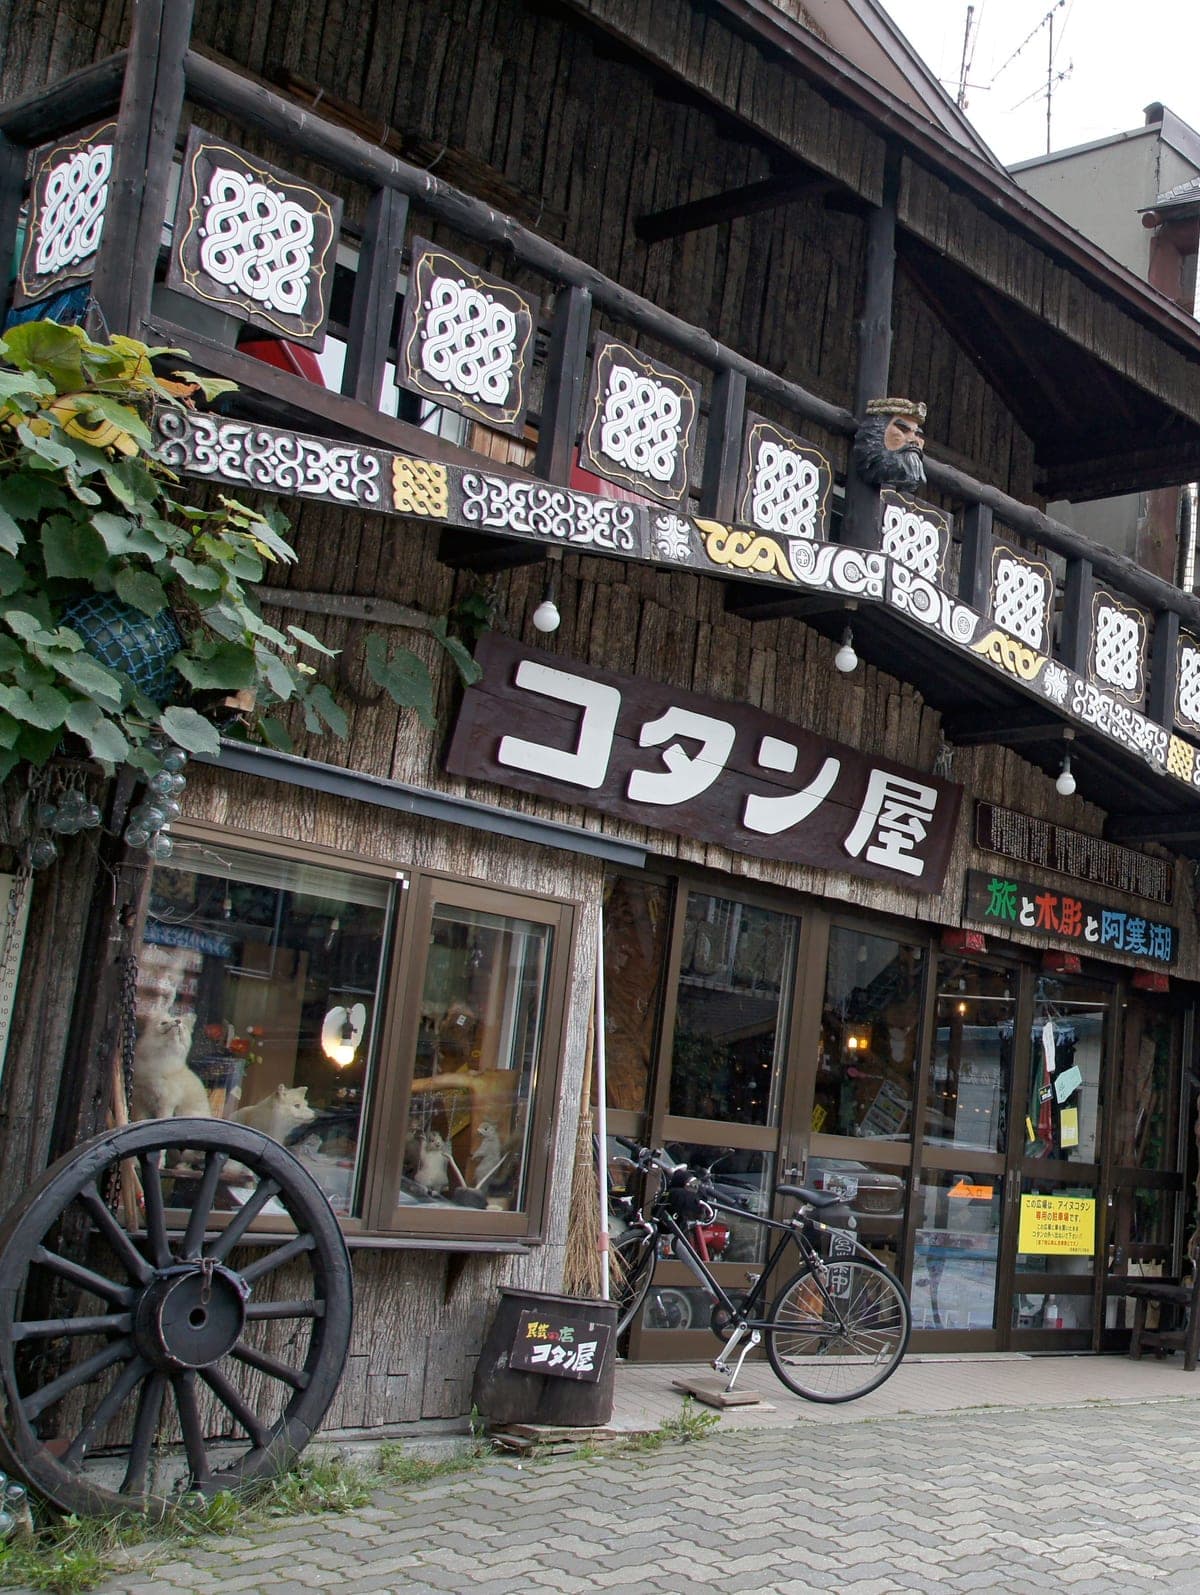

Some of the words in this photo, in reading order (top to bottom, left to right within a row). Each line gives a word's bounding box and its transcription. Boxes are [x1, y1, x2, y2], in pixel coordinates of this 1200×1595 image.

[498, 660, 938, 877] コタン屋
[985, 877, 1172, 962] 旅と木彫と阿寒湖
[525, 1321, 575, 1343] 民芸の店
[531, 1340, 598, 1372] コタン屋
